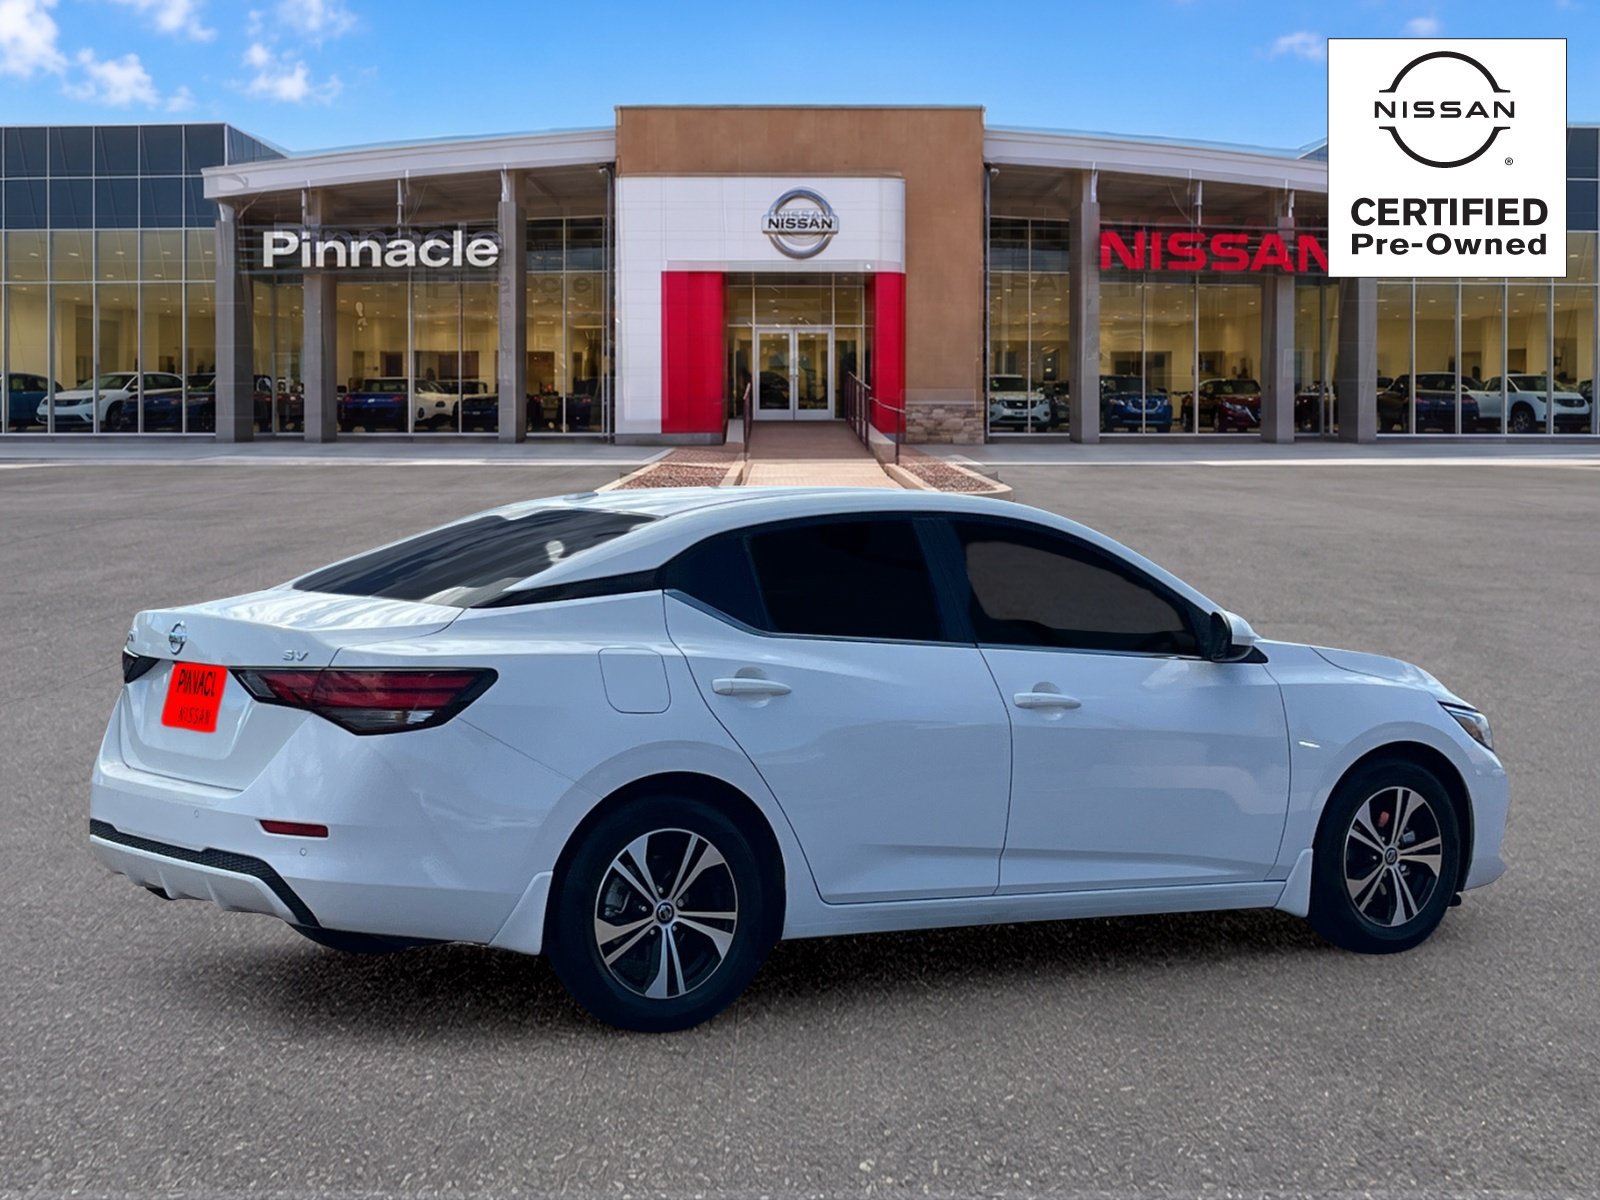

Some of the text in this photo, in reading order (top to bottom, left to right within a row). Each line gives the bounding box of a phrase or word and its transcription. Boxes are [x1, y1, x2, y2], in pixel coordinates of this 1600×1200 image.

[768, 218, 833, 229] NISSAN
[263, 230, 499, 268] Pinnacle
[282, 649, 309, 662] SV
